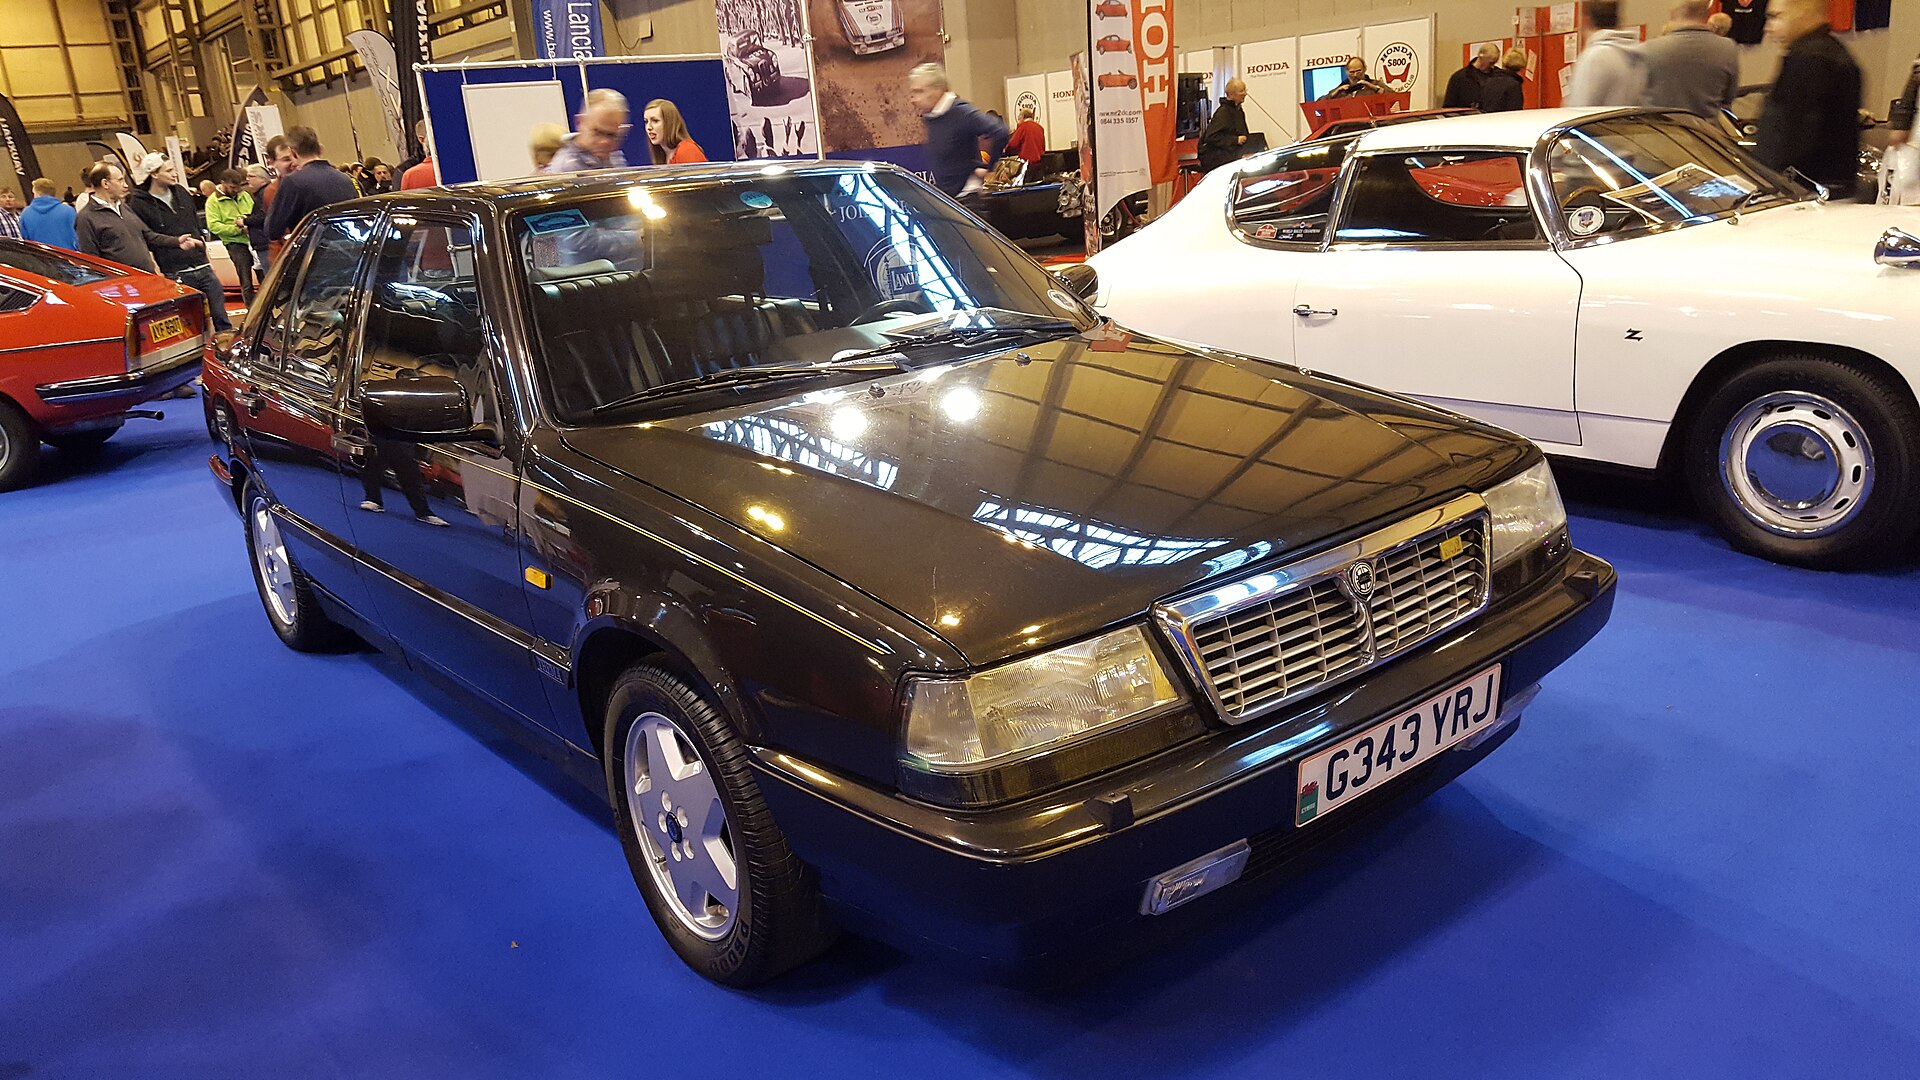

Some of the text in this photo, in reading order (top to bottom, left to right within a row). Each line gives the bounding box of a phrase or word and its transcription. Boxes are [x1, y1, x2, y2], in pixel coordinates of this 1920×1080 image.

[416, 0, 430, 62] UXHA
[567, 2, 596, 59] Lancia
[1306, 54, 1352, 67] HONDA
[1380, 46, 1413, 63] HONDA
[1387, 58, 1407, 67] S800
[1247, 62, 1290, 74] HONDA
[1403, 75, 1415, 89] CLUB
[236, 122, 253, 169] SSAN
[1326, 673, 1494, 801] G343 YRJ
